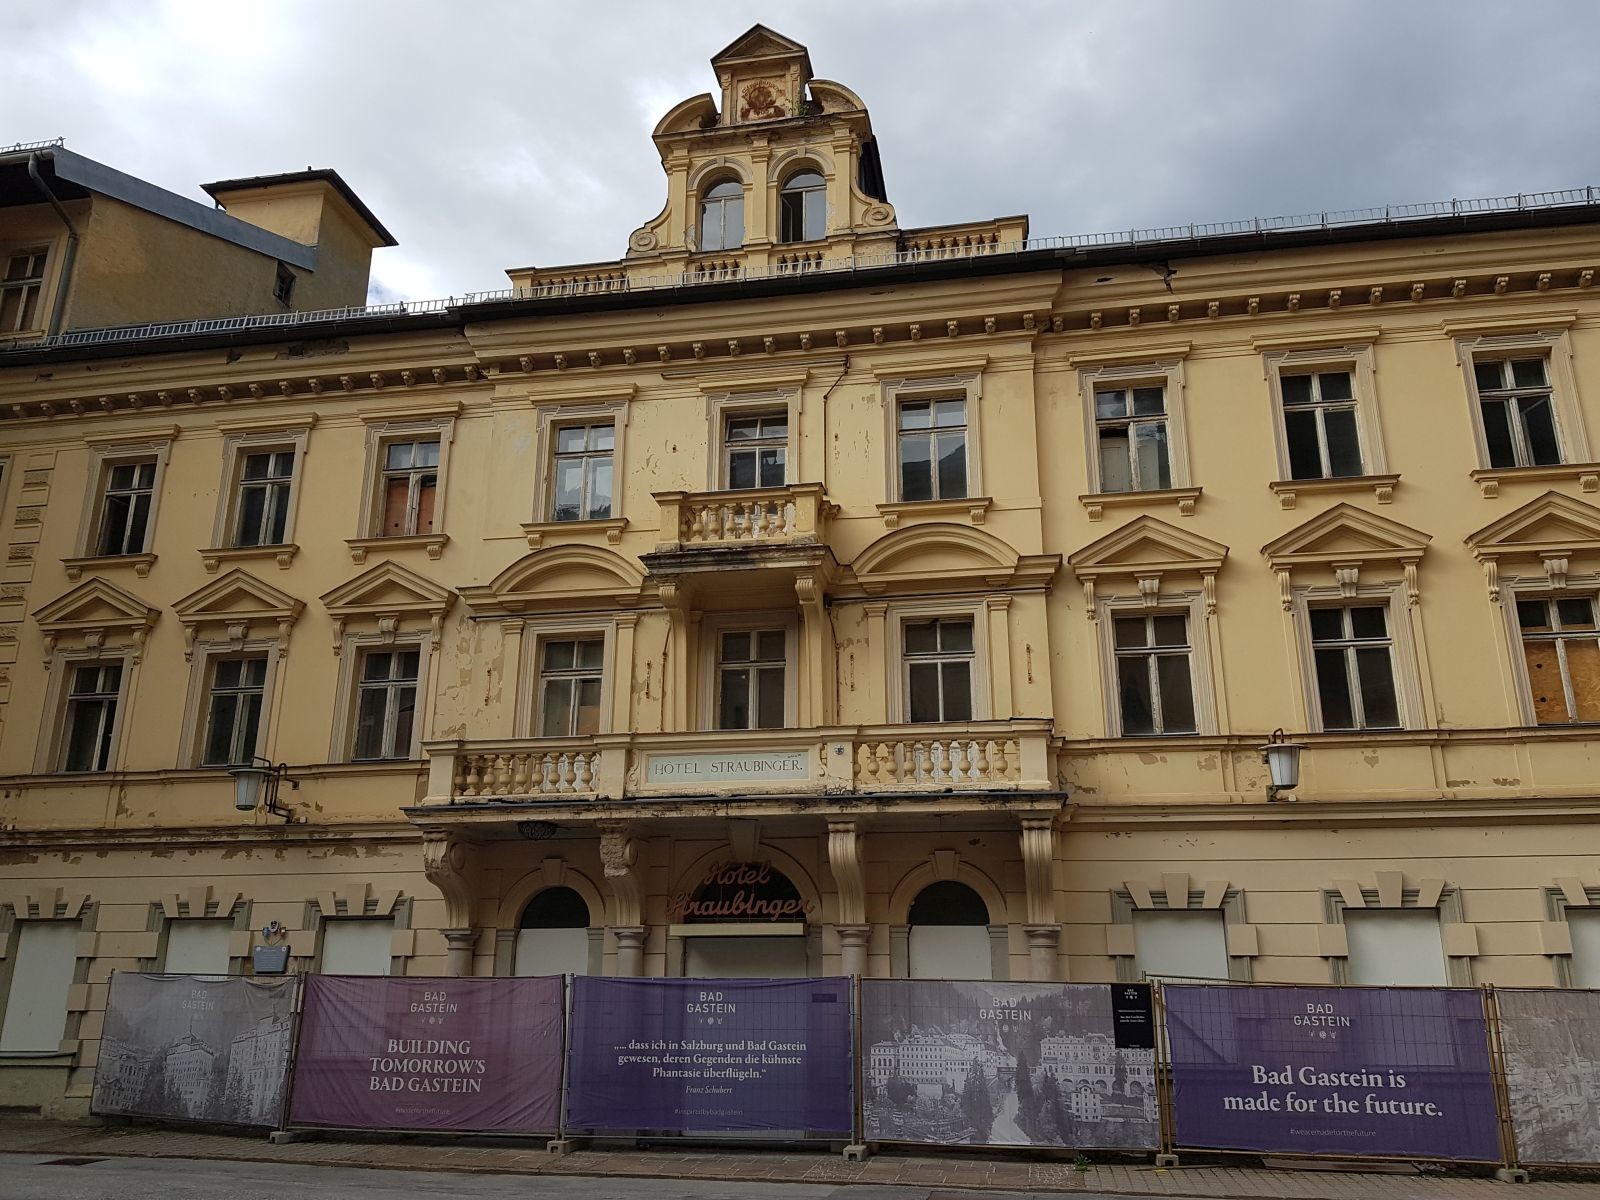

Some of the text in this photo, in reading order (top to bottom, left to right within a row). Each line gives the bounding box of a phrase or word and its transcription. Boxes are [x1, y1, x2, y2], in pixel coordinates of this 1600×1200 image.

[704, 862, 771, 886] Hotel
[666, 890, 816, 922] Straubinger
[424, 991, 447, 1001] BAD
[700, 992, 723, 1001] BAD
[992, 996, 1017, 1008] BAD
[410, 1003, 458, 1013] GASTEIN
[686, 1003, 736, 1013] GASTEIN
[1306, 1003, 1334, 1014] BAD
[979, 1008, 1032, 1021] GASTEIN
[1293, 1015, 1350, 1027] GASTEIN
[387, 1039, 471, 1055] BUILDING
[628, 1040, 649, 1050] dass
[651, 1040, 666, 1050] ich
[668, 1040, 677, 1051] in
[680, 1040, 723, 1053] Salzburg
[725, 1041, 745, 1051] und
[747, 1041, 766, 1051] Bad
[768, 1041, 807, 1051] Gastein
[617, 1053, 802, 1066] gewesen, deren Gegenden die kühnste
[653, 1067, 702, 1078] Phantasie
[1251, 1065, 1406, 1088] Bad Gastein is
[369, 1076, 482, 1093] BAD GASTEIN
[685, 1085, 733, 1095] Franz Schubert
[1223, 1091, 1443, 1117] made for the future.
